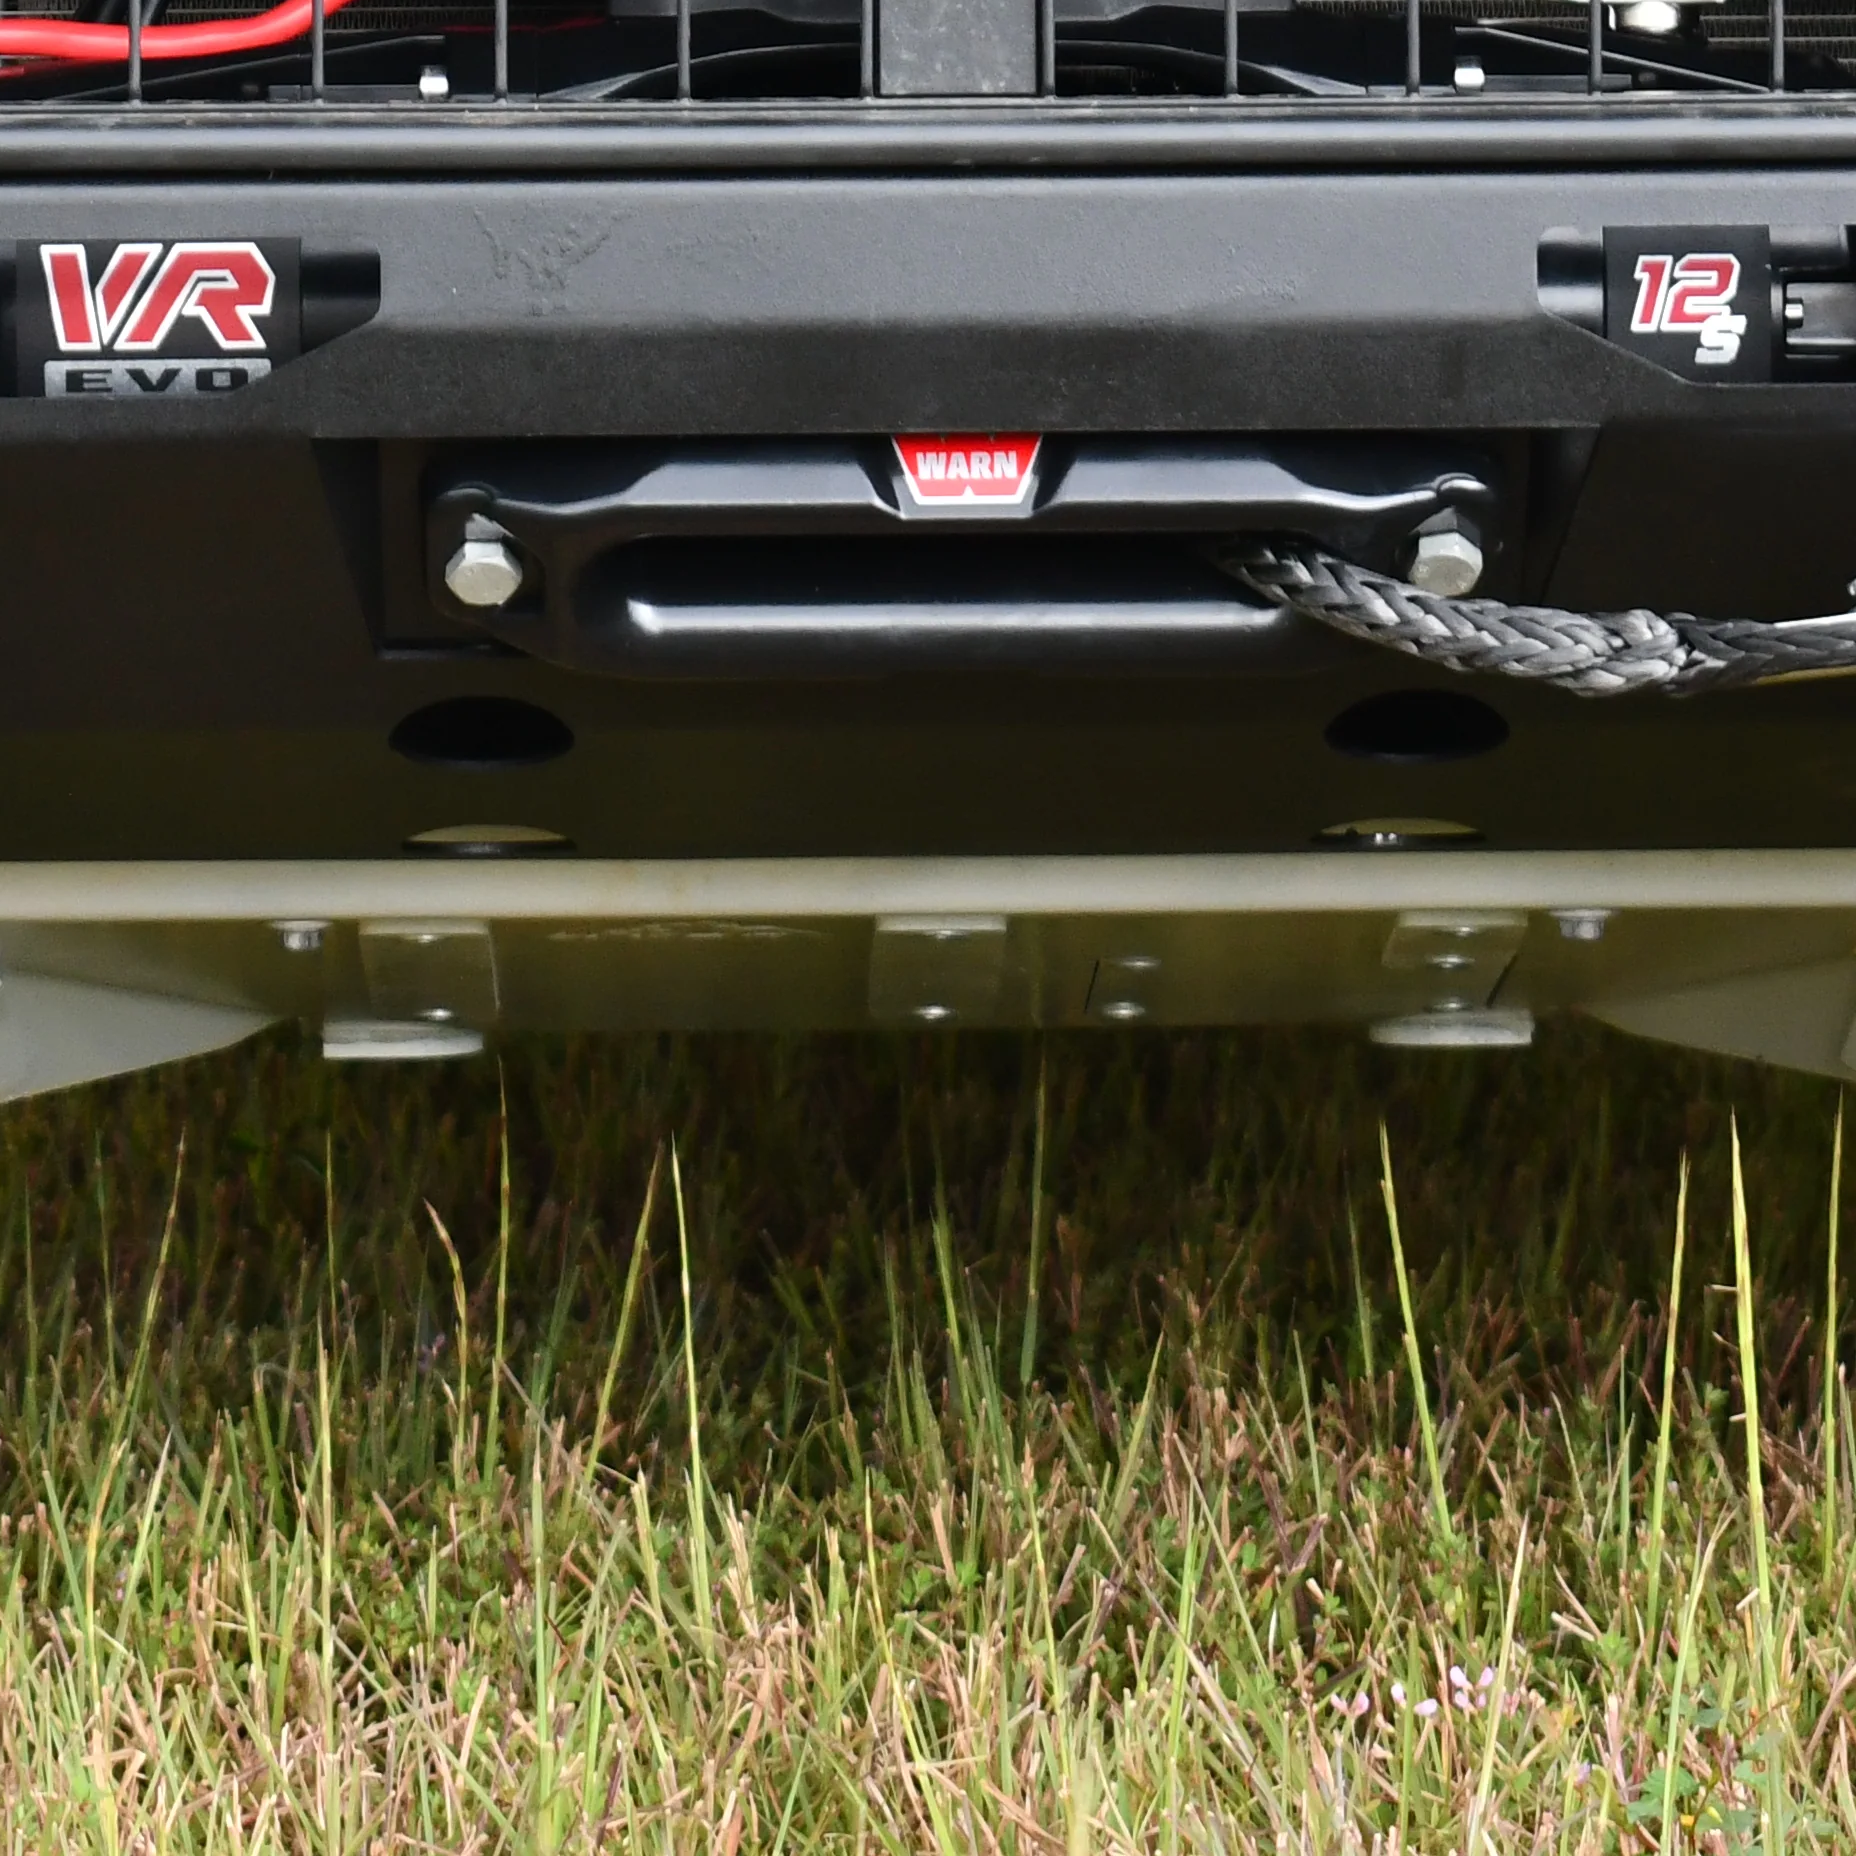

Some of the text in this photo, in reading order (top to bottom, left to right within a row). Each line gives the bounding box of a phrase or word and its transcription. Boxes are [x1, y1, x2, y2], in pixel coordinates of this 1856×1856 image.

[40, 242, 276, 351] VR
[65, 367, 249, 393] EVO
[916, 451, 1018, 480] WARN
